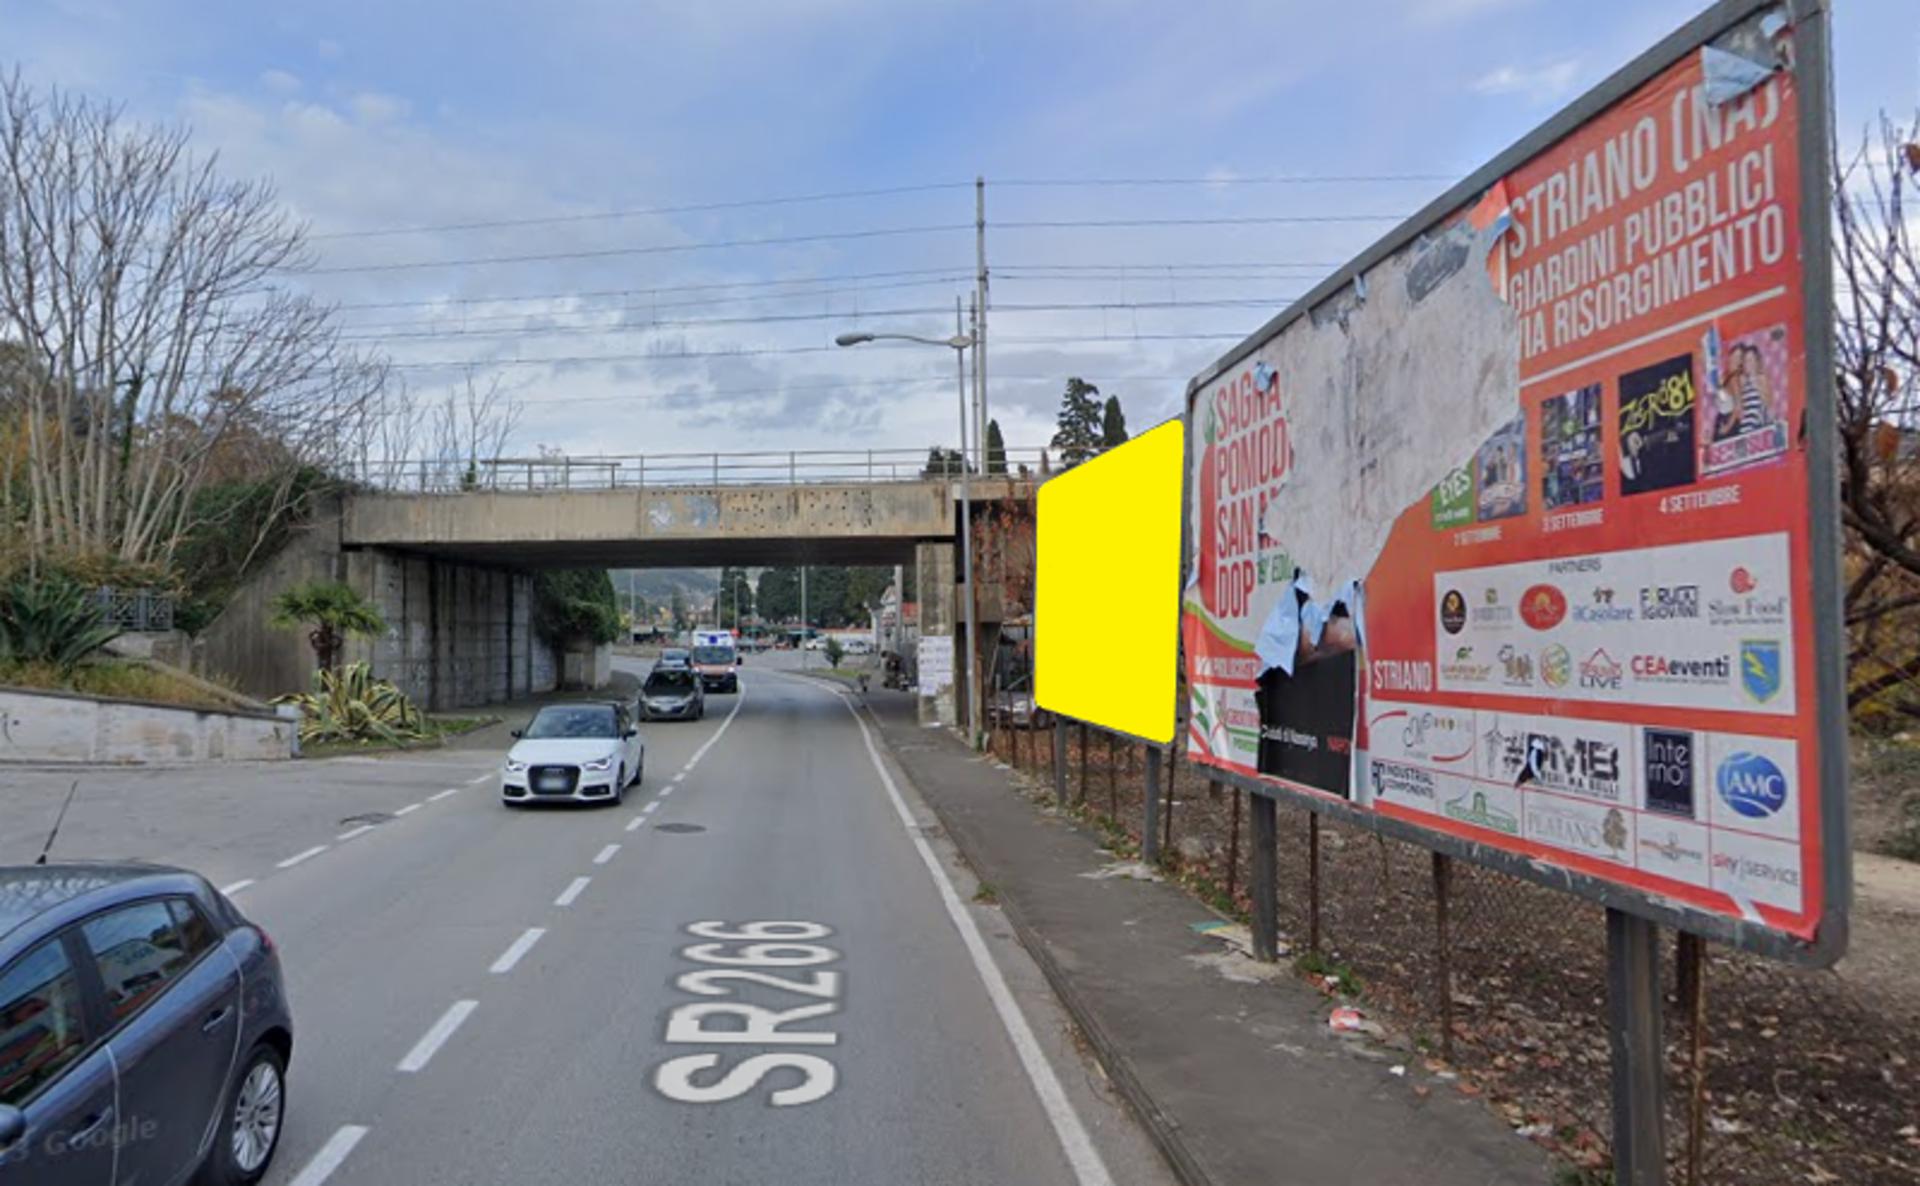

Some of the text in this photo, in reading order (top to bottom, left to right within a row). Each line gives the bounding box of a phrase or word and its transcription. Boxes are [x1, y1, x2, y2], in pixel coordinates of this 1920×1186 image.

[1511, 116, 1657, 259] STRIANO
[1509, 142, 1775, 315] GIARDINI PUBBLICI
[1554, 204, 1784, 348] RISORGIMENTO
[1659, 484, 1741, 513] 4 SETTEMBRE
[1217, 494, 1254, 560] SAN
[1551, 507, 1604, 530] SETTEMBRE
[1548, 558, 1602, 575] PARTNERS
[1218, 559, 1255, 619] DOP
[1708, 598, 1787, 617] Slow Food
[1373, 660, 1433, 692] STRIANO
[1630, 654, 1730, 678] CEAeventi
[1579, 676, 1622, 691] LIVE
[1386, 764, 1434, 787] INDUSTRIAL
[1728, 772, 1782, 800] AMC
[1528, 810, 1601, 849] PLATANO
